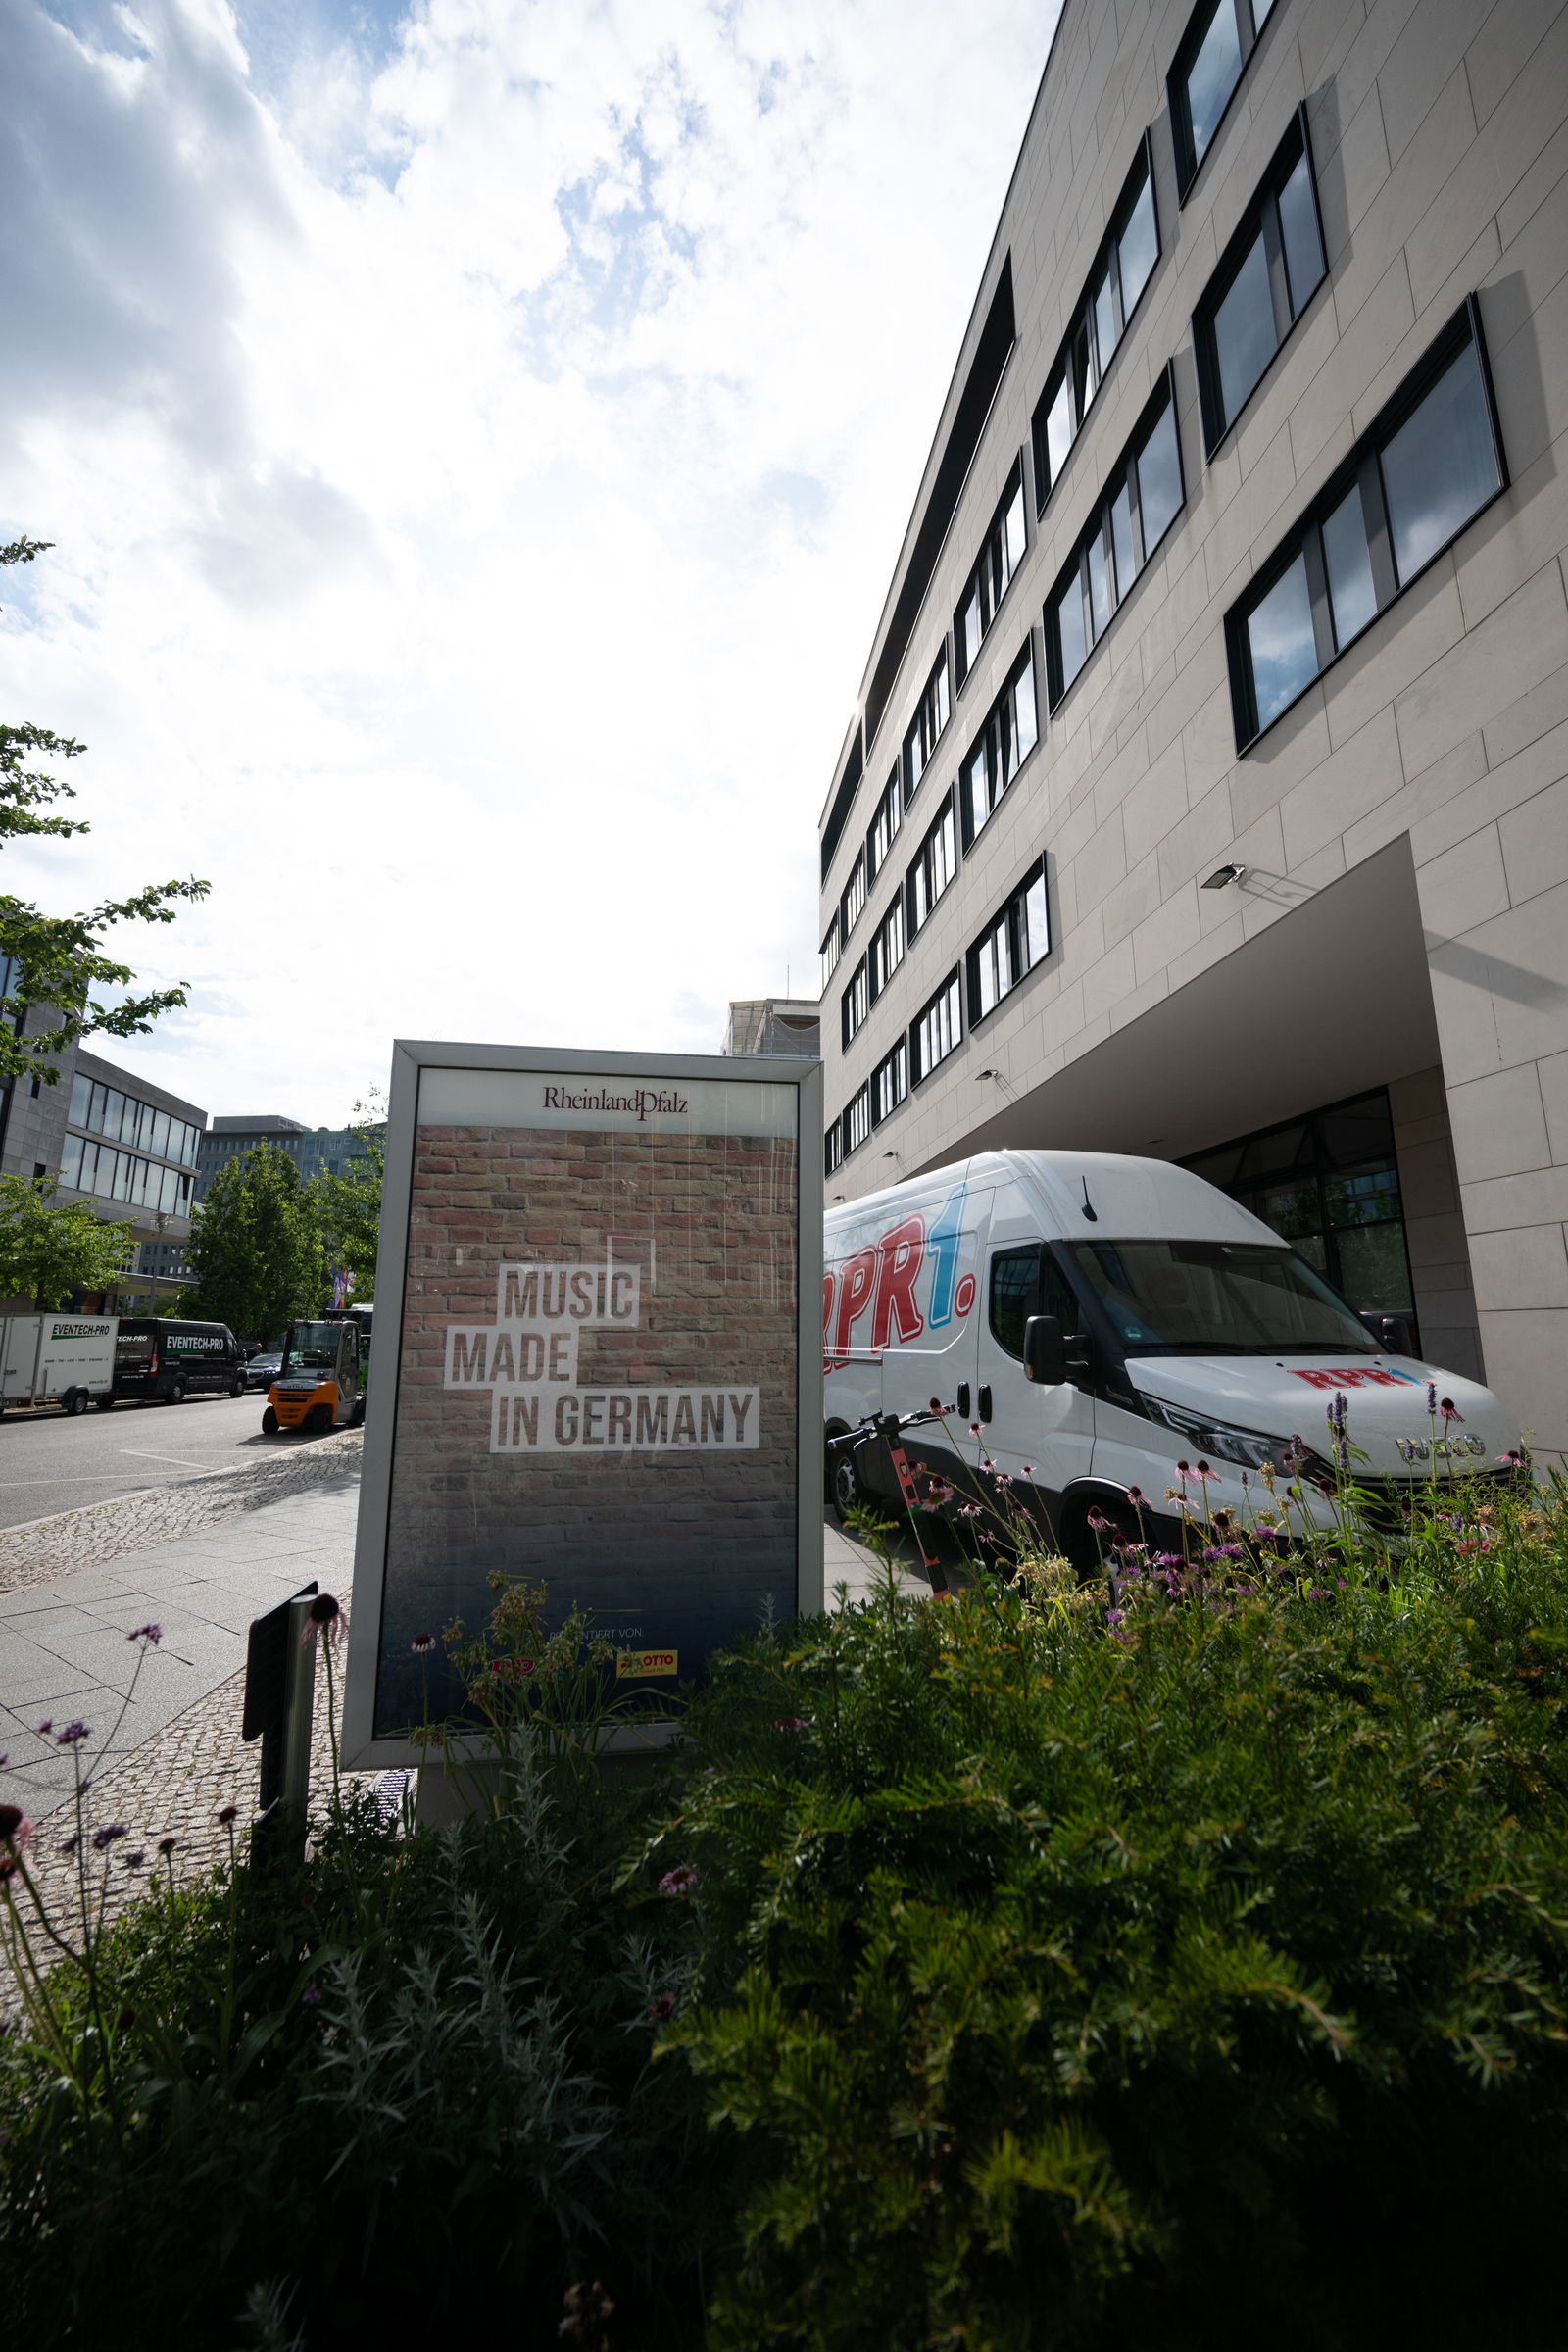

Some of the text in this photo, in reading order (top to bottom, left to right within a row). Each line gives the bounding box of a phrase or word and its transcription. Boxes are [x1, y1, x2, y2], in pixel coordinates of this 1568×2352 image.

[504, 1270, 633, 1319] MUSIC
[823, 1181, 976, 1376] PR1.
[52, 1324, 110, 1335] EVENTECH-PRO
[166, 1336, 224, 1350] EVENTECH-PRO
[452, 1332, 572, 1383] MADE
[497, 1393, 753, 1446] IN GERMANY
[643, 1654, 674, 1667] OTTO
